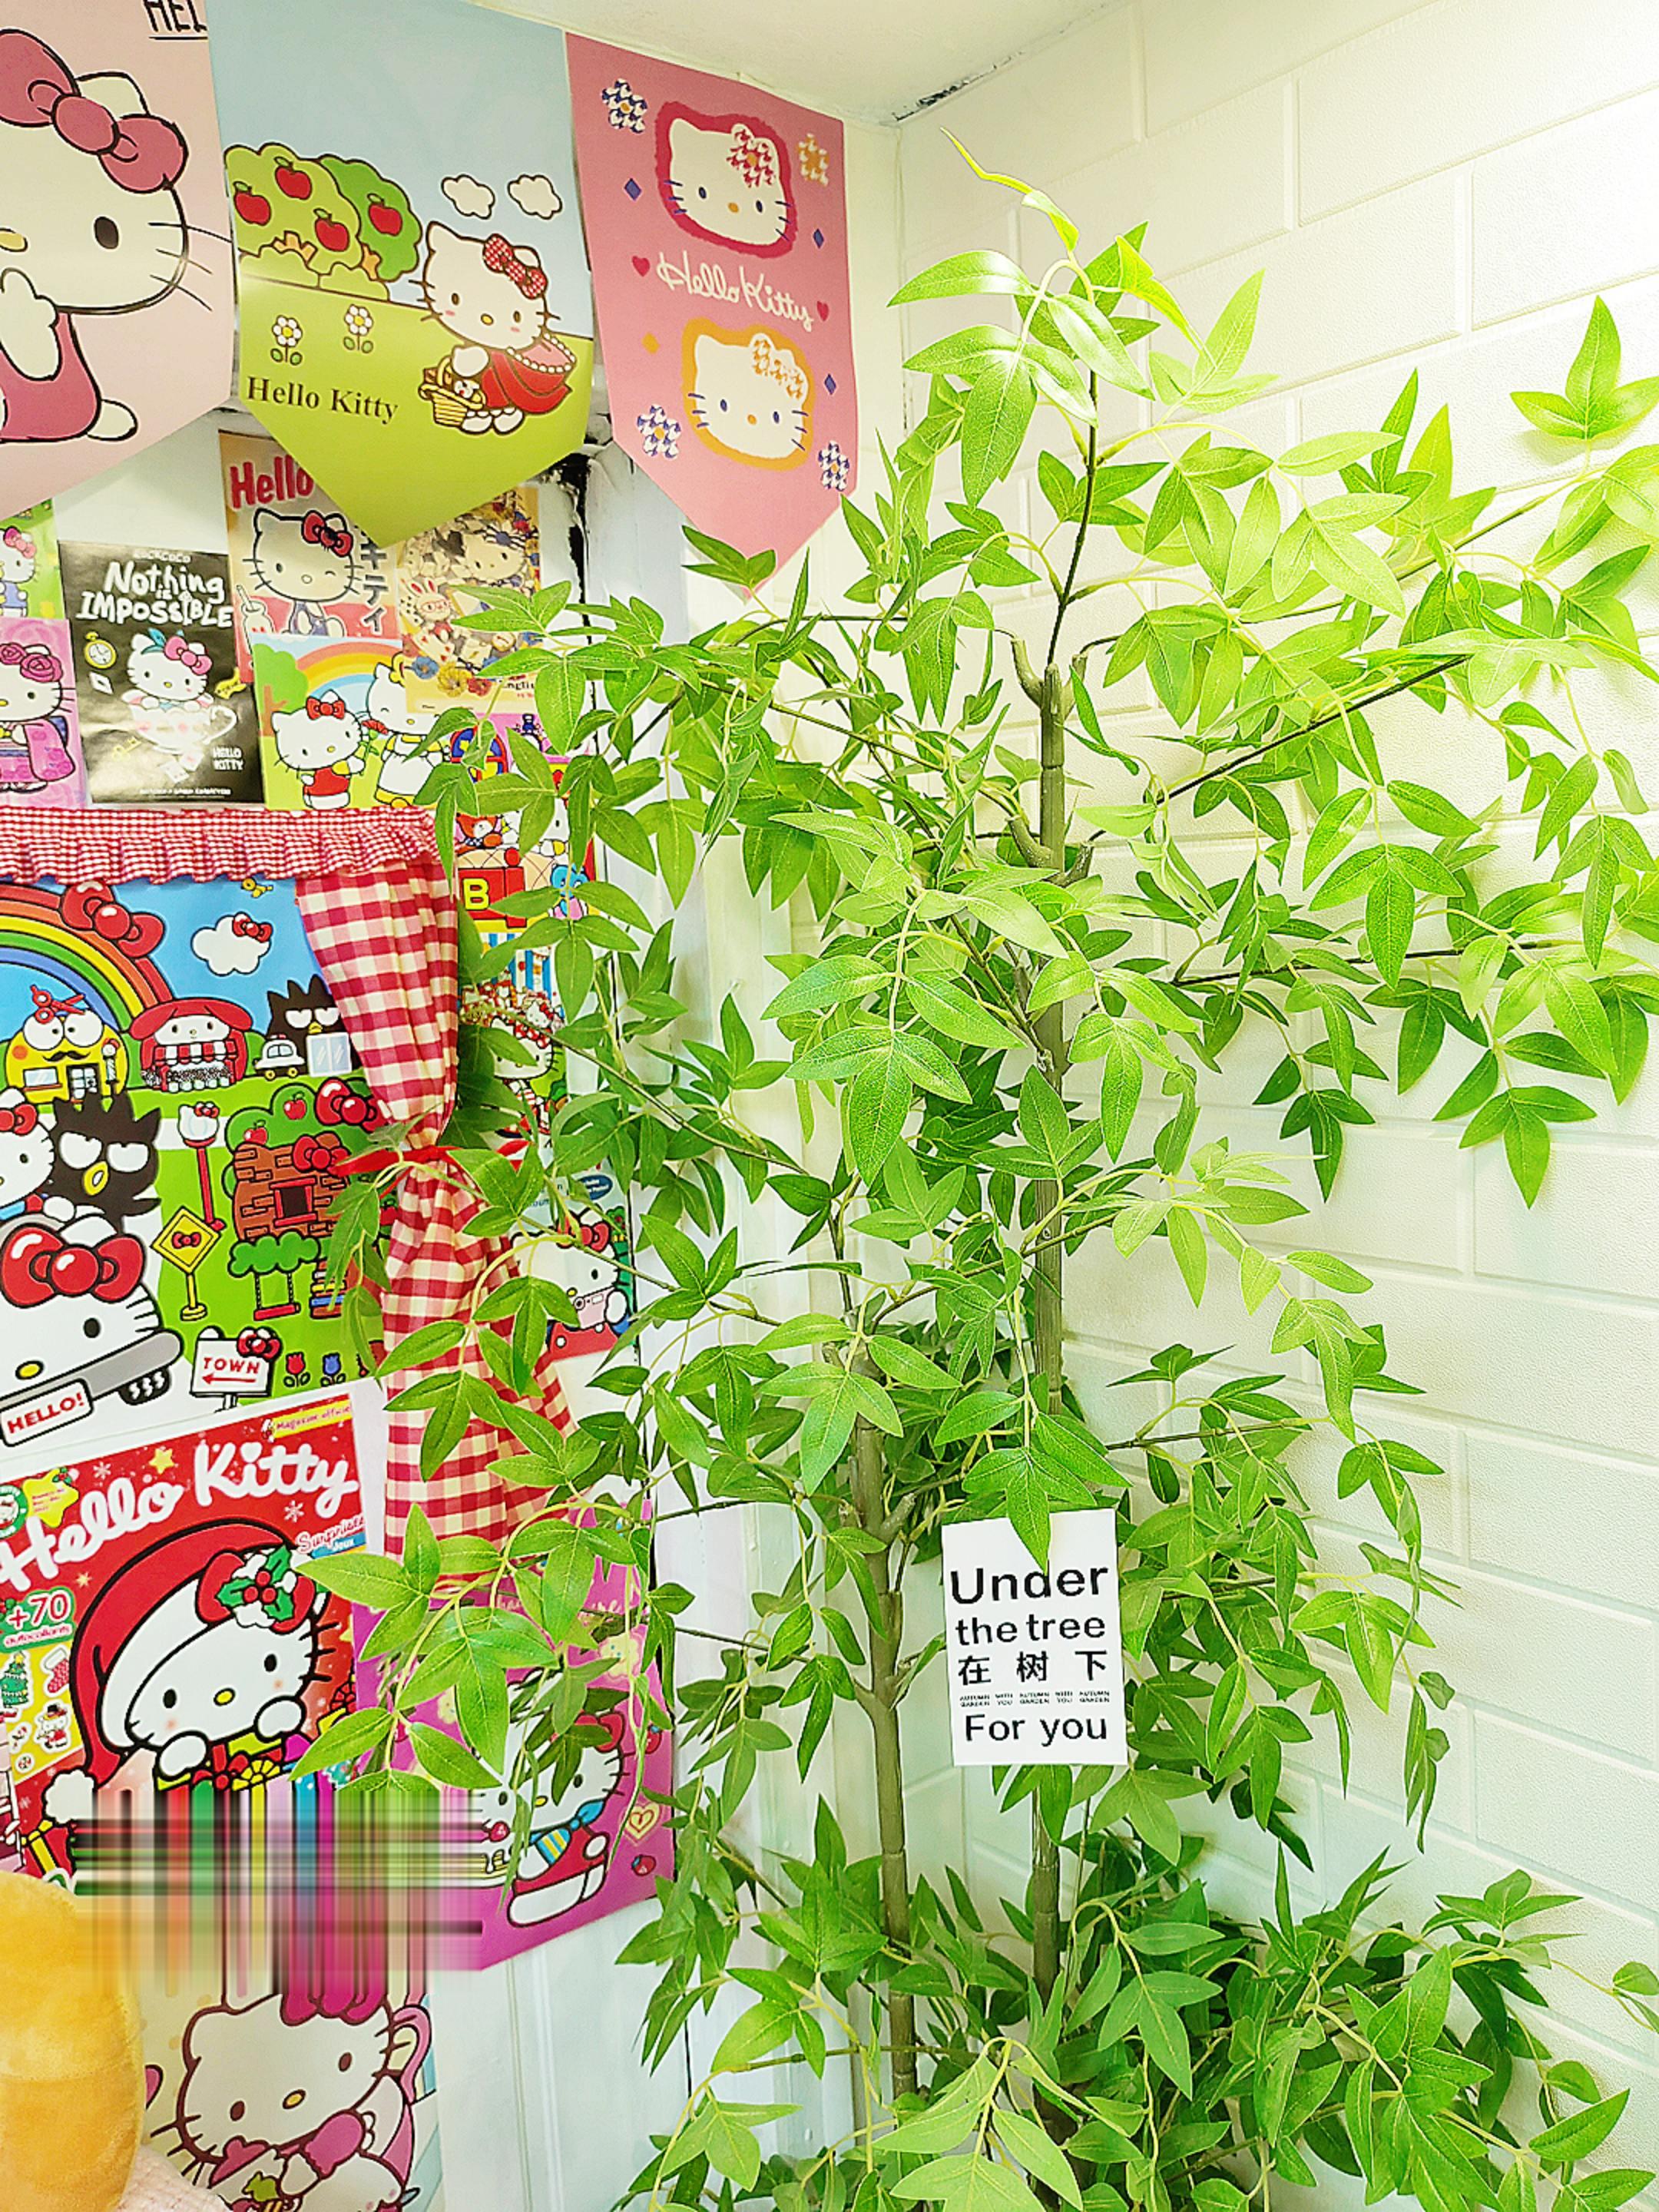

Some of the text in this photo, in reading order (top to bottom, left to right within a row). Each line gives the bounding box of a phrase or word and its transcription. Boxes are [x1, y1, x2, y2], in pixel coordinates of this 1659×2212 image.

[657, 250, 814, 333] Hello Kitty
[247, 376, 399, 425] Hello Kitty
[230, 454, 314, 509] Hello
[104, 561, 225, 604] Nothing
[75, 591, 234, 628] IMPOSSIBLE
[213, 747, 243, 758] HELLO
[462, 878, 489, 910] B
[204, 1356, 260, 1374] TOWN
[7, 1392, 84, 1435] HELLO!
[0, 1442, 359, 1591] Hello Kitty
[950, 1560, 1108, 1604] Under
[8, 1592, 69, 1628] +70
[955, 1614, 1106, 1646] the tree
[965, 1714, 1108, 1747] For you
